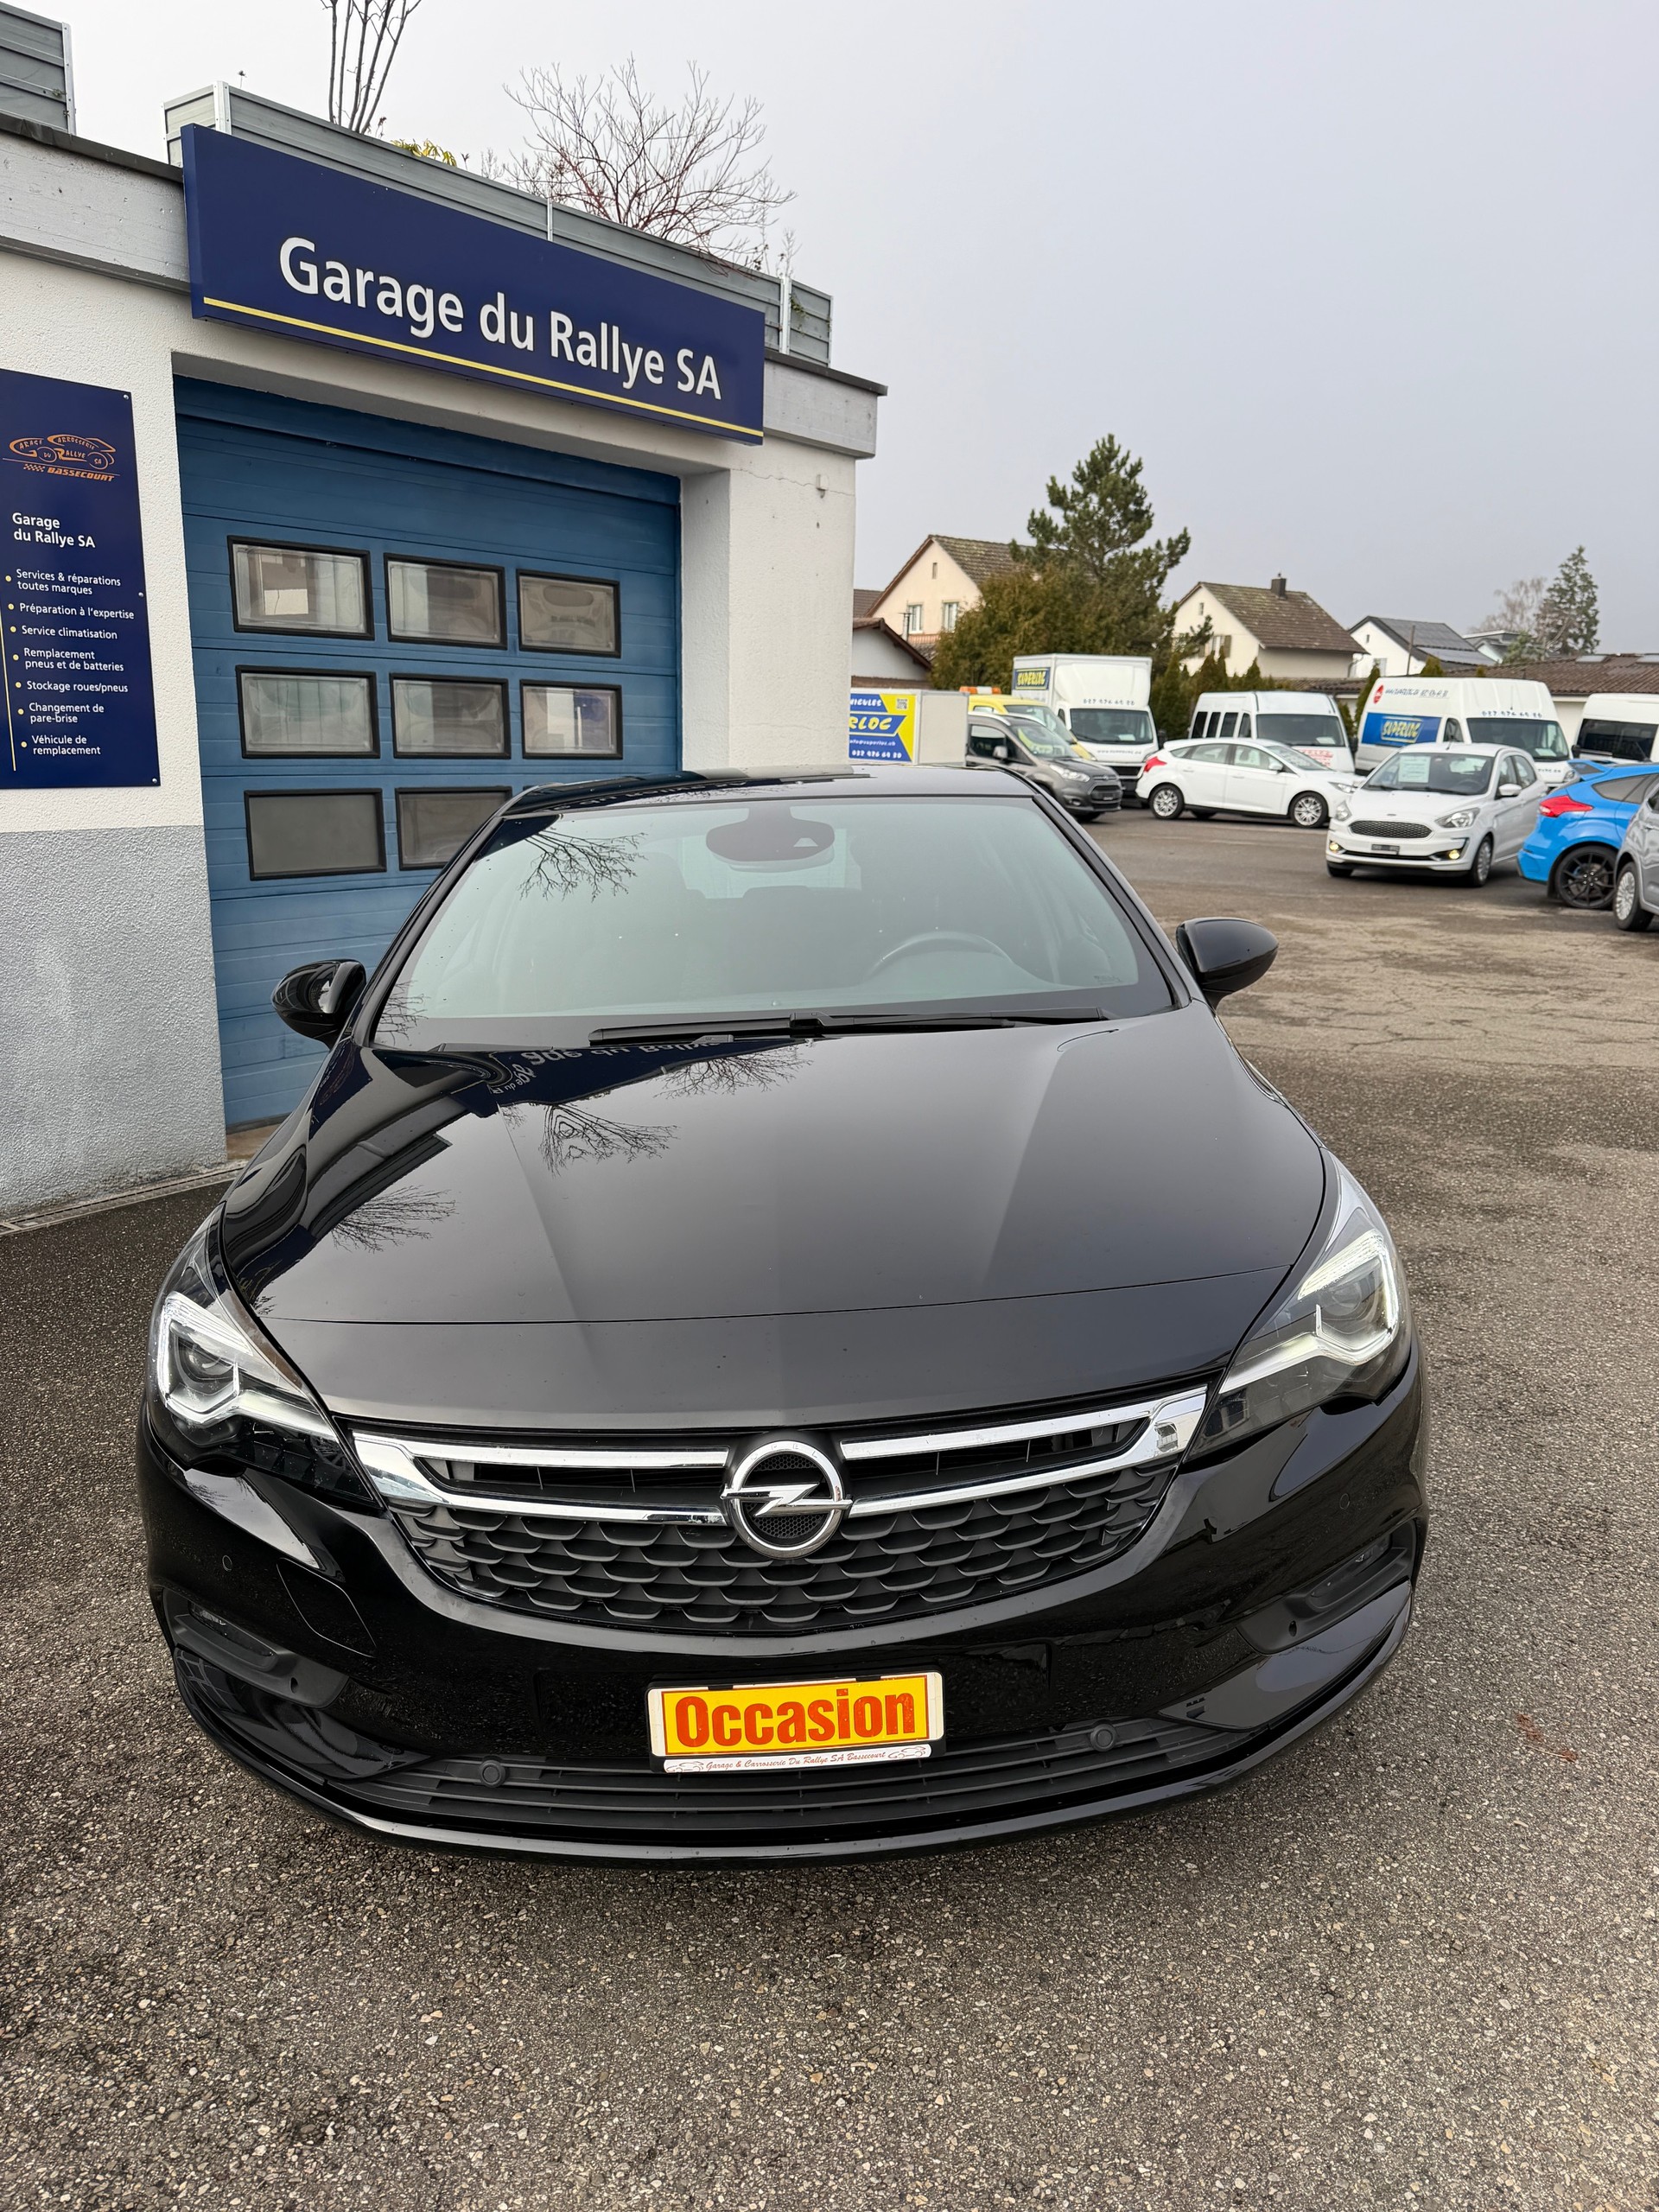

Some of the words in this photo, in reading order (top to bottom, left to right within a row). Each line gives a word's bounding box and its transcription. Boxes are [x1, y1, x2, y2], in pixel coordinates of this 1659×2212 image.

[279, 236, 463, 339] Garage
[479, 291, 534, 351] du
[550, 311, 664, 391] Rallye
[677, 348, 721, 400] SA
[47, 467, 115, 481] BASSECOURT
[12, 512, 60, 531] Garage
[14, 528, 31, 542] du
[35, 531, 74, 548] Rallye
[78, 536, 96, 548] SA
[16, 569, 55, 582] Services
[58, 572, 65, 582] &
[68, 574, 121, 586] réparations
[17, 581, 49, 592] toutes
[52, 585, 92, 595] marques
[20, 602, 77, 615] Préparation
[79, 607, 86, 616] à
[88, 607, 135, 620] l'expertise
[22, 625, 56, 636] Service
[58, 627, 118, 639] climatisation
[24, 648, 95, 659] Remplacement
[25, 660, 54, 670] pneus
[57, 661, 67, 670] et
[69, 660, 80, 670] de
[84, 661, 124, 671] batteries
[27, 681, 71, 693] Stockage
[73, 683, 128, 694] roues/pneus
[29, 702, 91, 714] Changement
[92, 703, 105, 713] de
[30, 714, 78, 724] pare-brise
[32, 734, 73, 744] Véhicule
[75, 734, 87, 744] de
[33, 746, 101, 757] remplacement
[675, 1688, 915, 1748] Occasion
[705, 1761, 734, 1770] Garage
[735, 1759, 741, 1768] &
[745, 1758, 786, 1768] Carrosserie
[804, 1755, 829, 1765] Rallye
[830, 1753, 844, 1762] SA
[847, 1751, 886, 1760] Bassecourt
